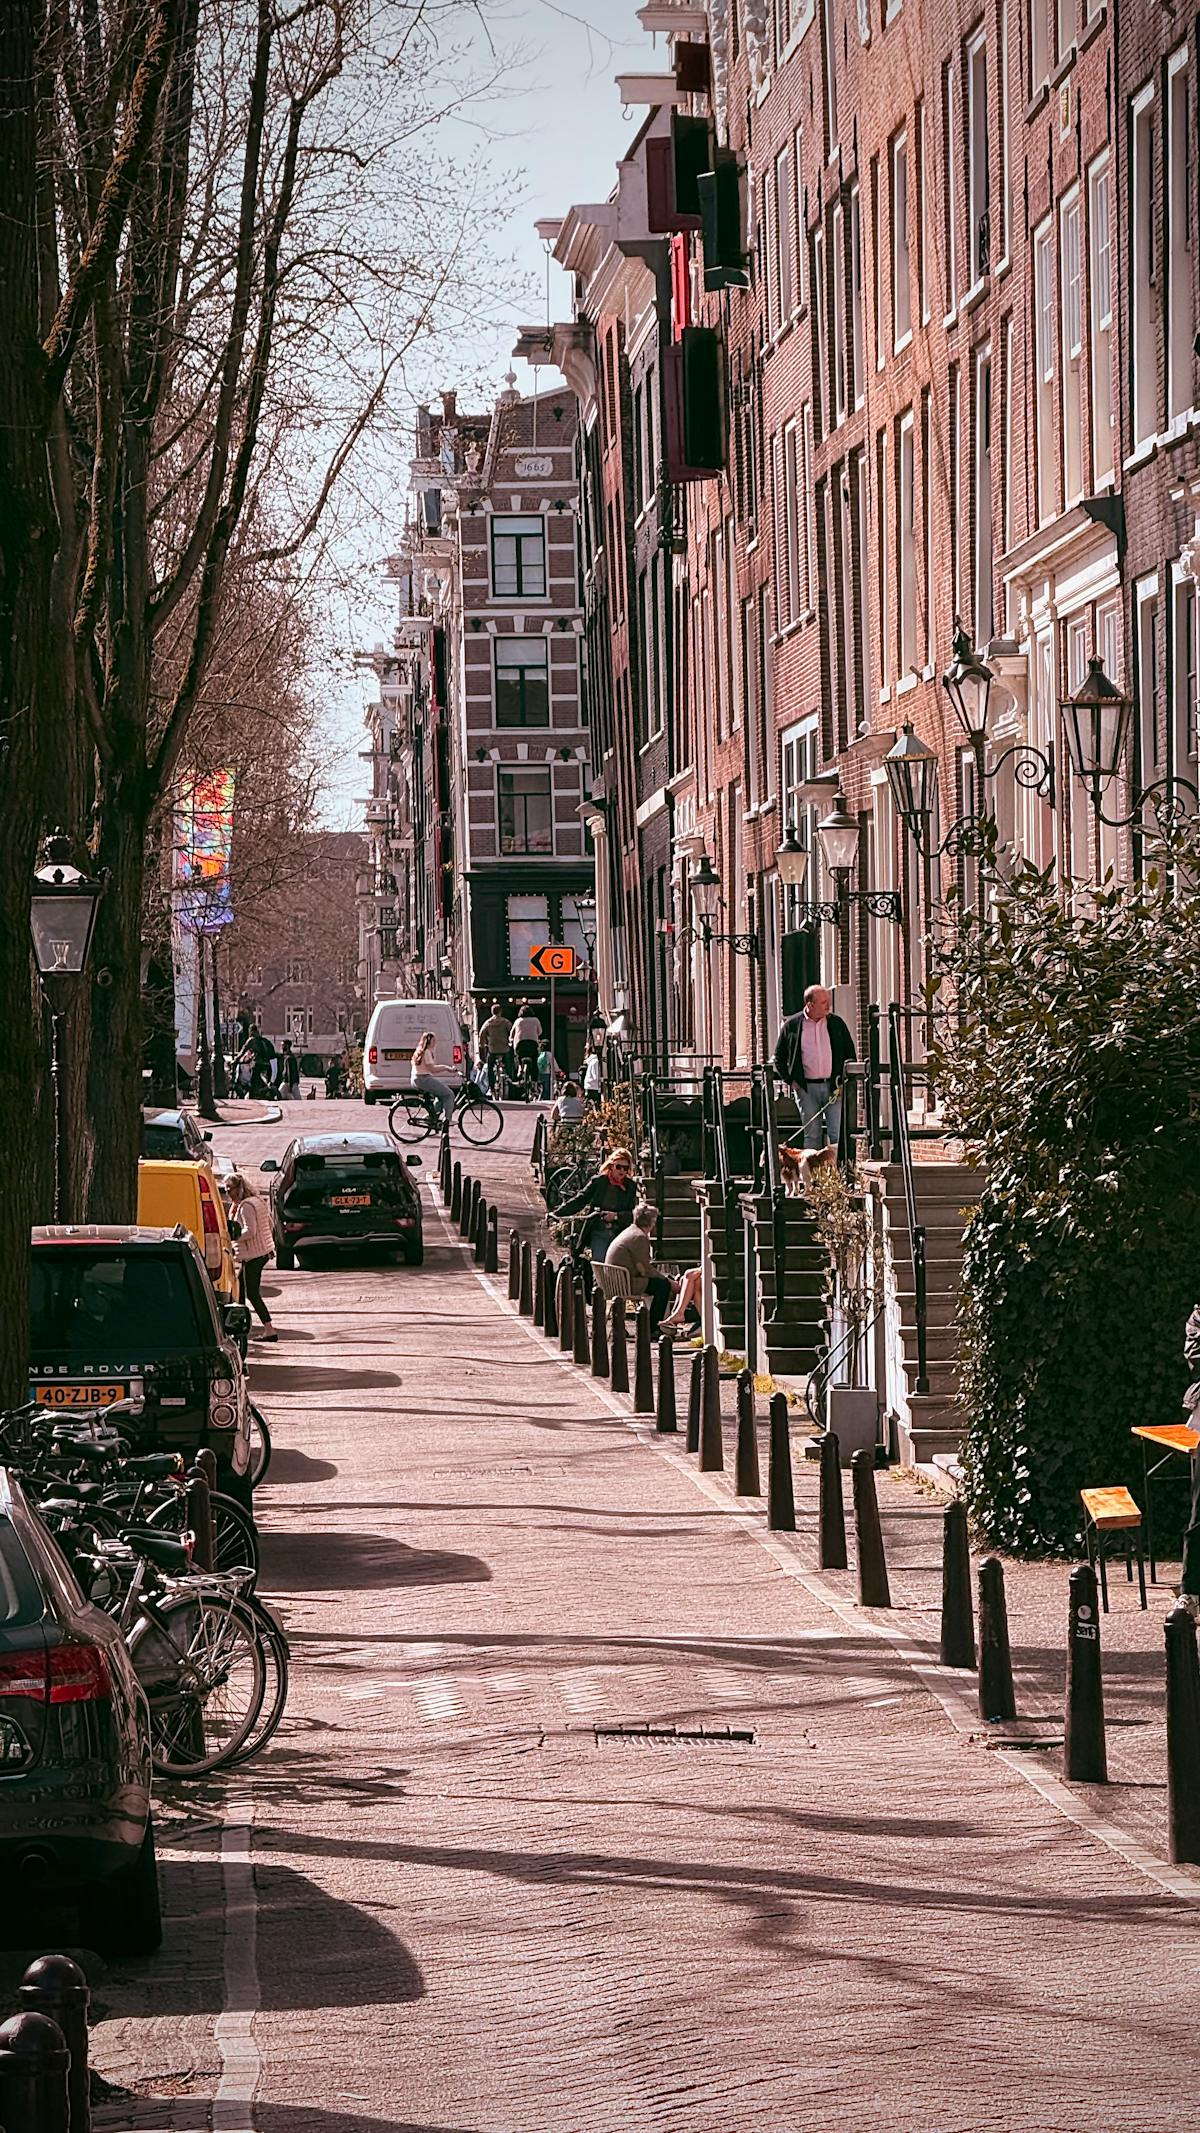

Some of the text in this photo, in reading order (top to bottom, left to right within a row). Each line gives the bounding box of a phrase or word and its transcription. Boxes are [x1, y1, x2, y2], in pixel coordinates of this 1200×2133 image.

[551, 953, 564, 969] G
[28, 1365, 155, 1374] NGE ROVER
[42, 1388, 118, 1404] 40-ZJB-9
